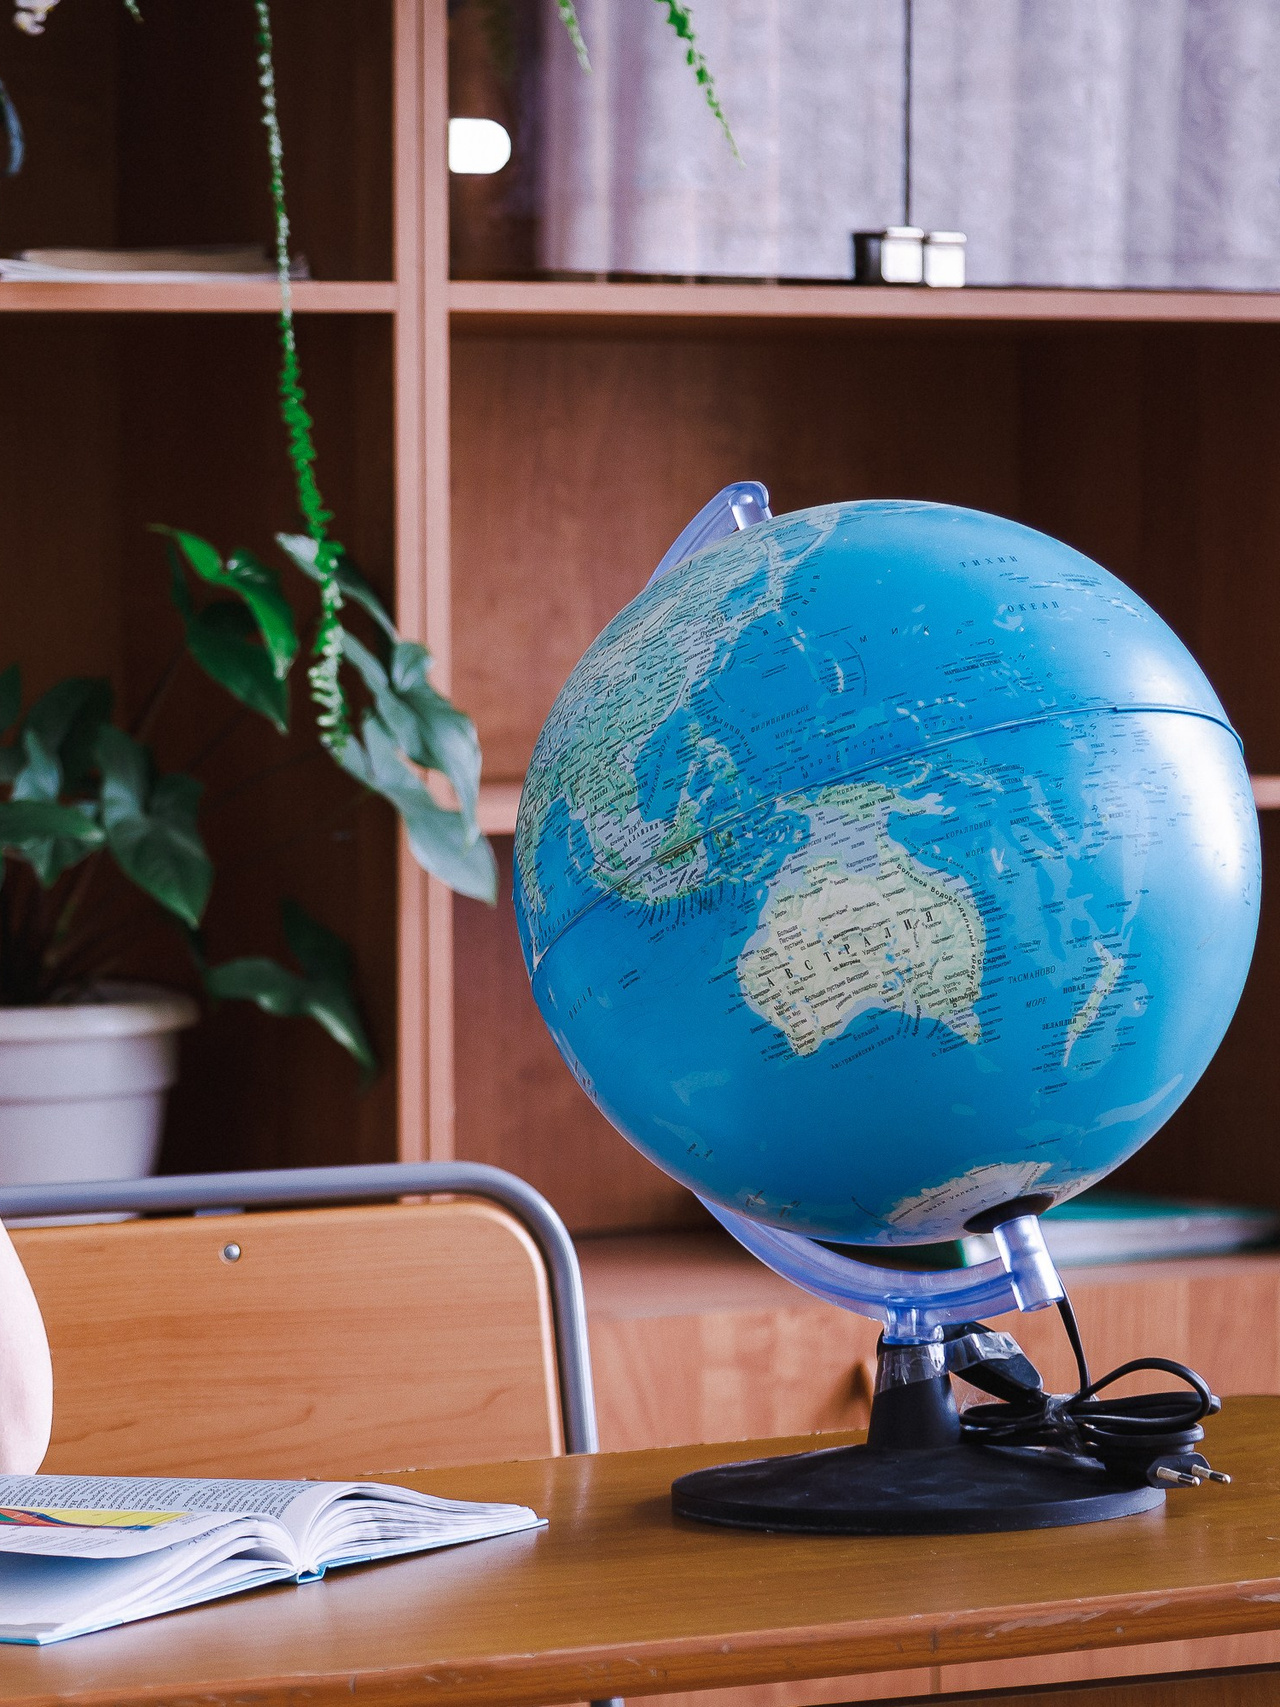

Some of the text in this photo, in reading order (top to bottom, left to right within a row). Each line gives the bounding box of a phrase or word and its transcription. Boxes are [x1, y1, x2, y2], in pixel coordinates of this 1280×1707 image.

[762, 574, 820, 636] ЯПОНИЯ
[1006, 601, 1059, 613] ОКЕАН
[750, 704, 810, 733] ФИЛИППИНСКОЕ
[774, 728, 795, 740] МОРЕ
[945, 820, 992, 840] КОРАЛЛОВОЕ
[965, 846, 986, 858] МОРЕ
[896, 863, 928, 888] Большой
[930, 886, 977, 949] Водораздельный
[765, 910, 934, 989] АВСТРАЛИЯ
[982, 953, 1007, 966] Сидней
[1008, 965, 1056, 984] ТАСМАНОВО
[1063, 982, 1087, 995] НОВАЯ
[949, 989, 979, 1004] Мельбурн
[1025, 996, 1049, 1009] МОРЕ
[1042, 1018, 1078, 1031] ЗЕЛАНДИЯ
